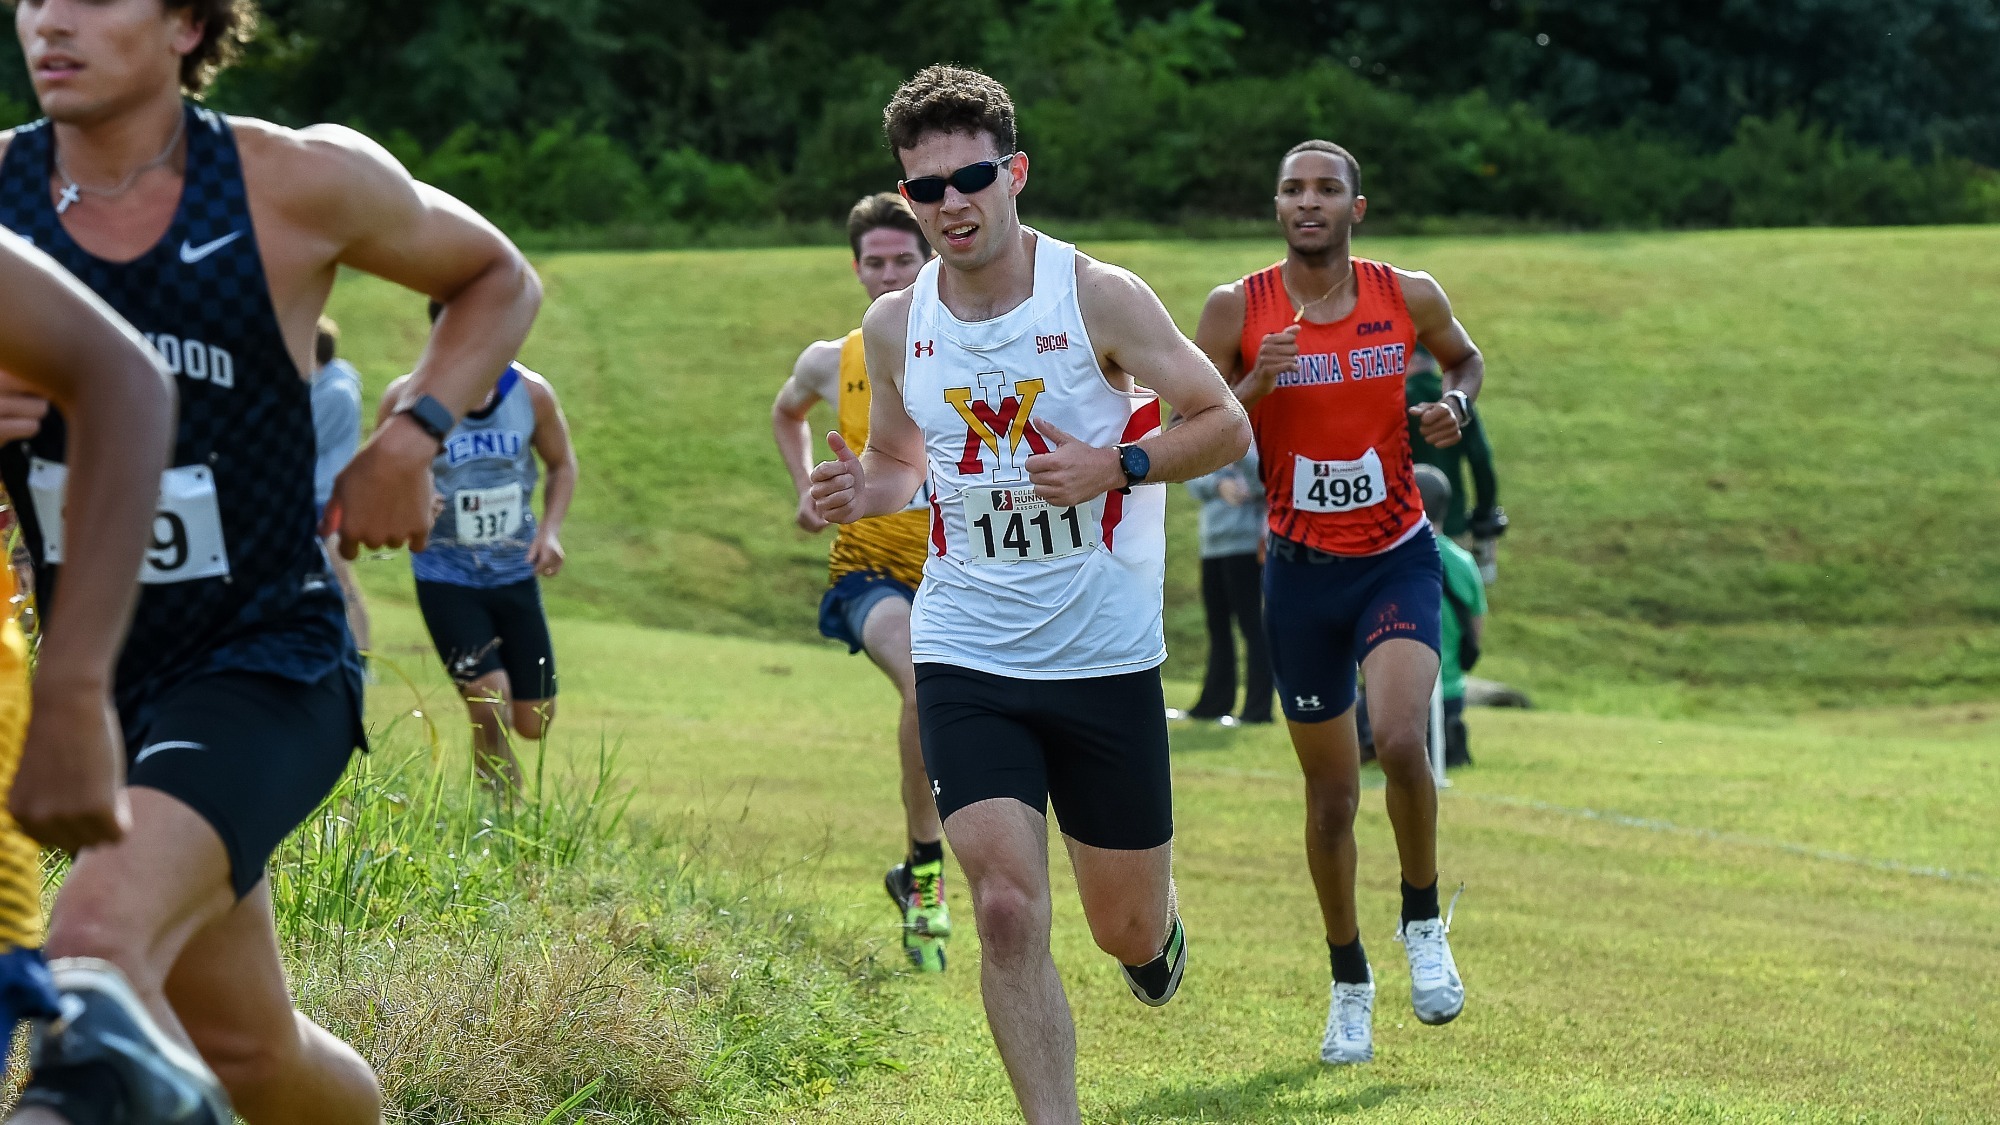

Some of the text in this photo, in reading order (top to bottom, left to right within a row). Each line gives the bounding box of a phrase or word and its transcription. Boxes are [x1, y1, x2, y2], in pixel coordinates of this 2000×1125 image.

[1357, 320, 1393, 336] CIAA
[144, 331, 235, 389] OOD
[1349, 342, 1405, 380] STATE
[446, 429, 519, 467] CNU
[1307, 474, 1373, 507] 498
[473, 510, 508, 538] 337
[973, 505, 1083, 558] 1411
